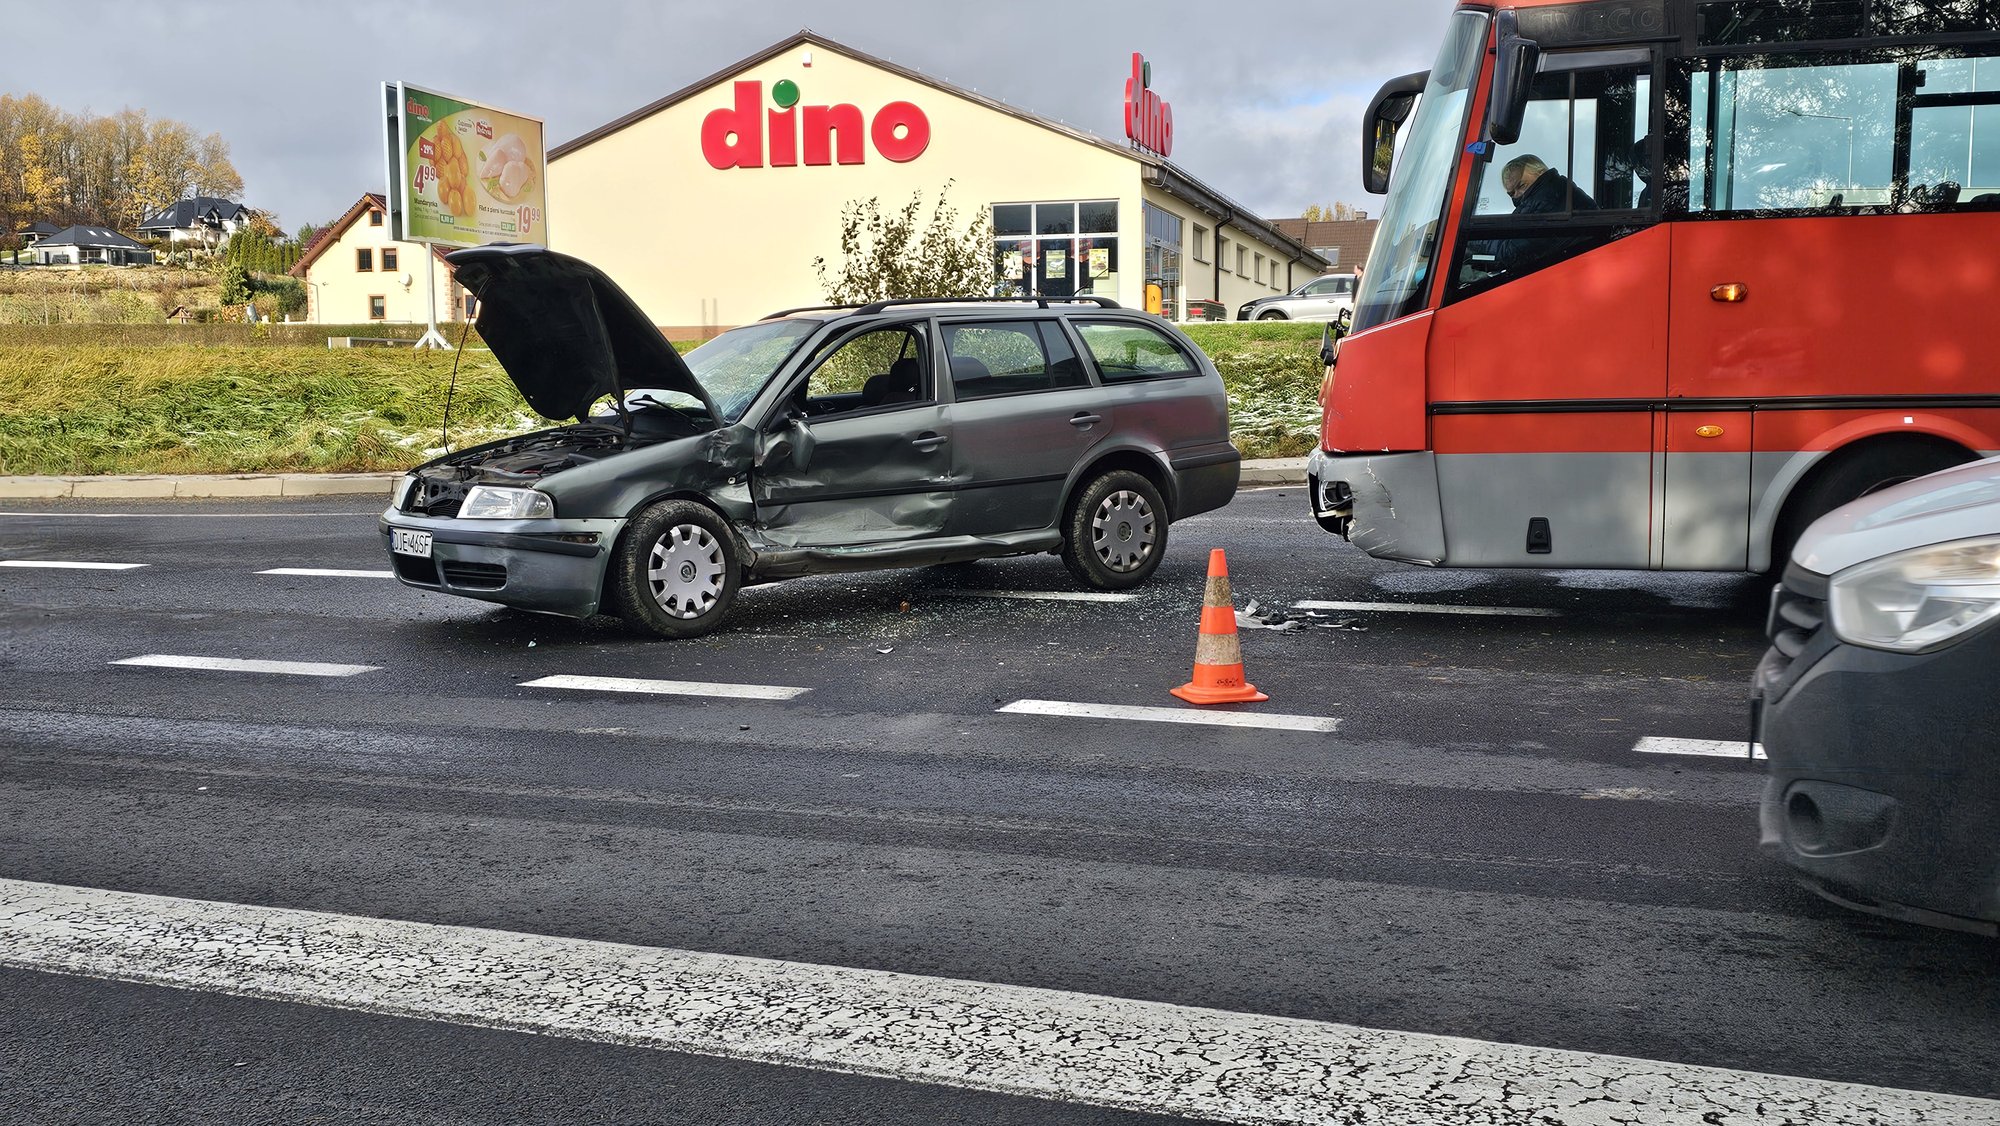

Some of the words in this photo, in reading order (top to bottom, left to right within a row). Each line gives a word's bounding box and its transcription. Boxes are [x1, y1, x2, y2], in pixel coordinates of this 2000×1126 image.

[407, 97, 429, 117] dino
[701, 79, 931, 170] dino
[1124, 52, 1173, 157] dino
